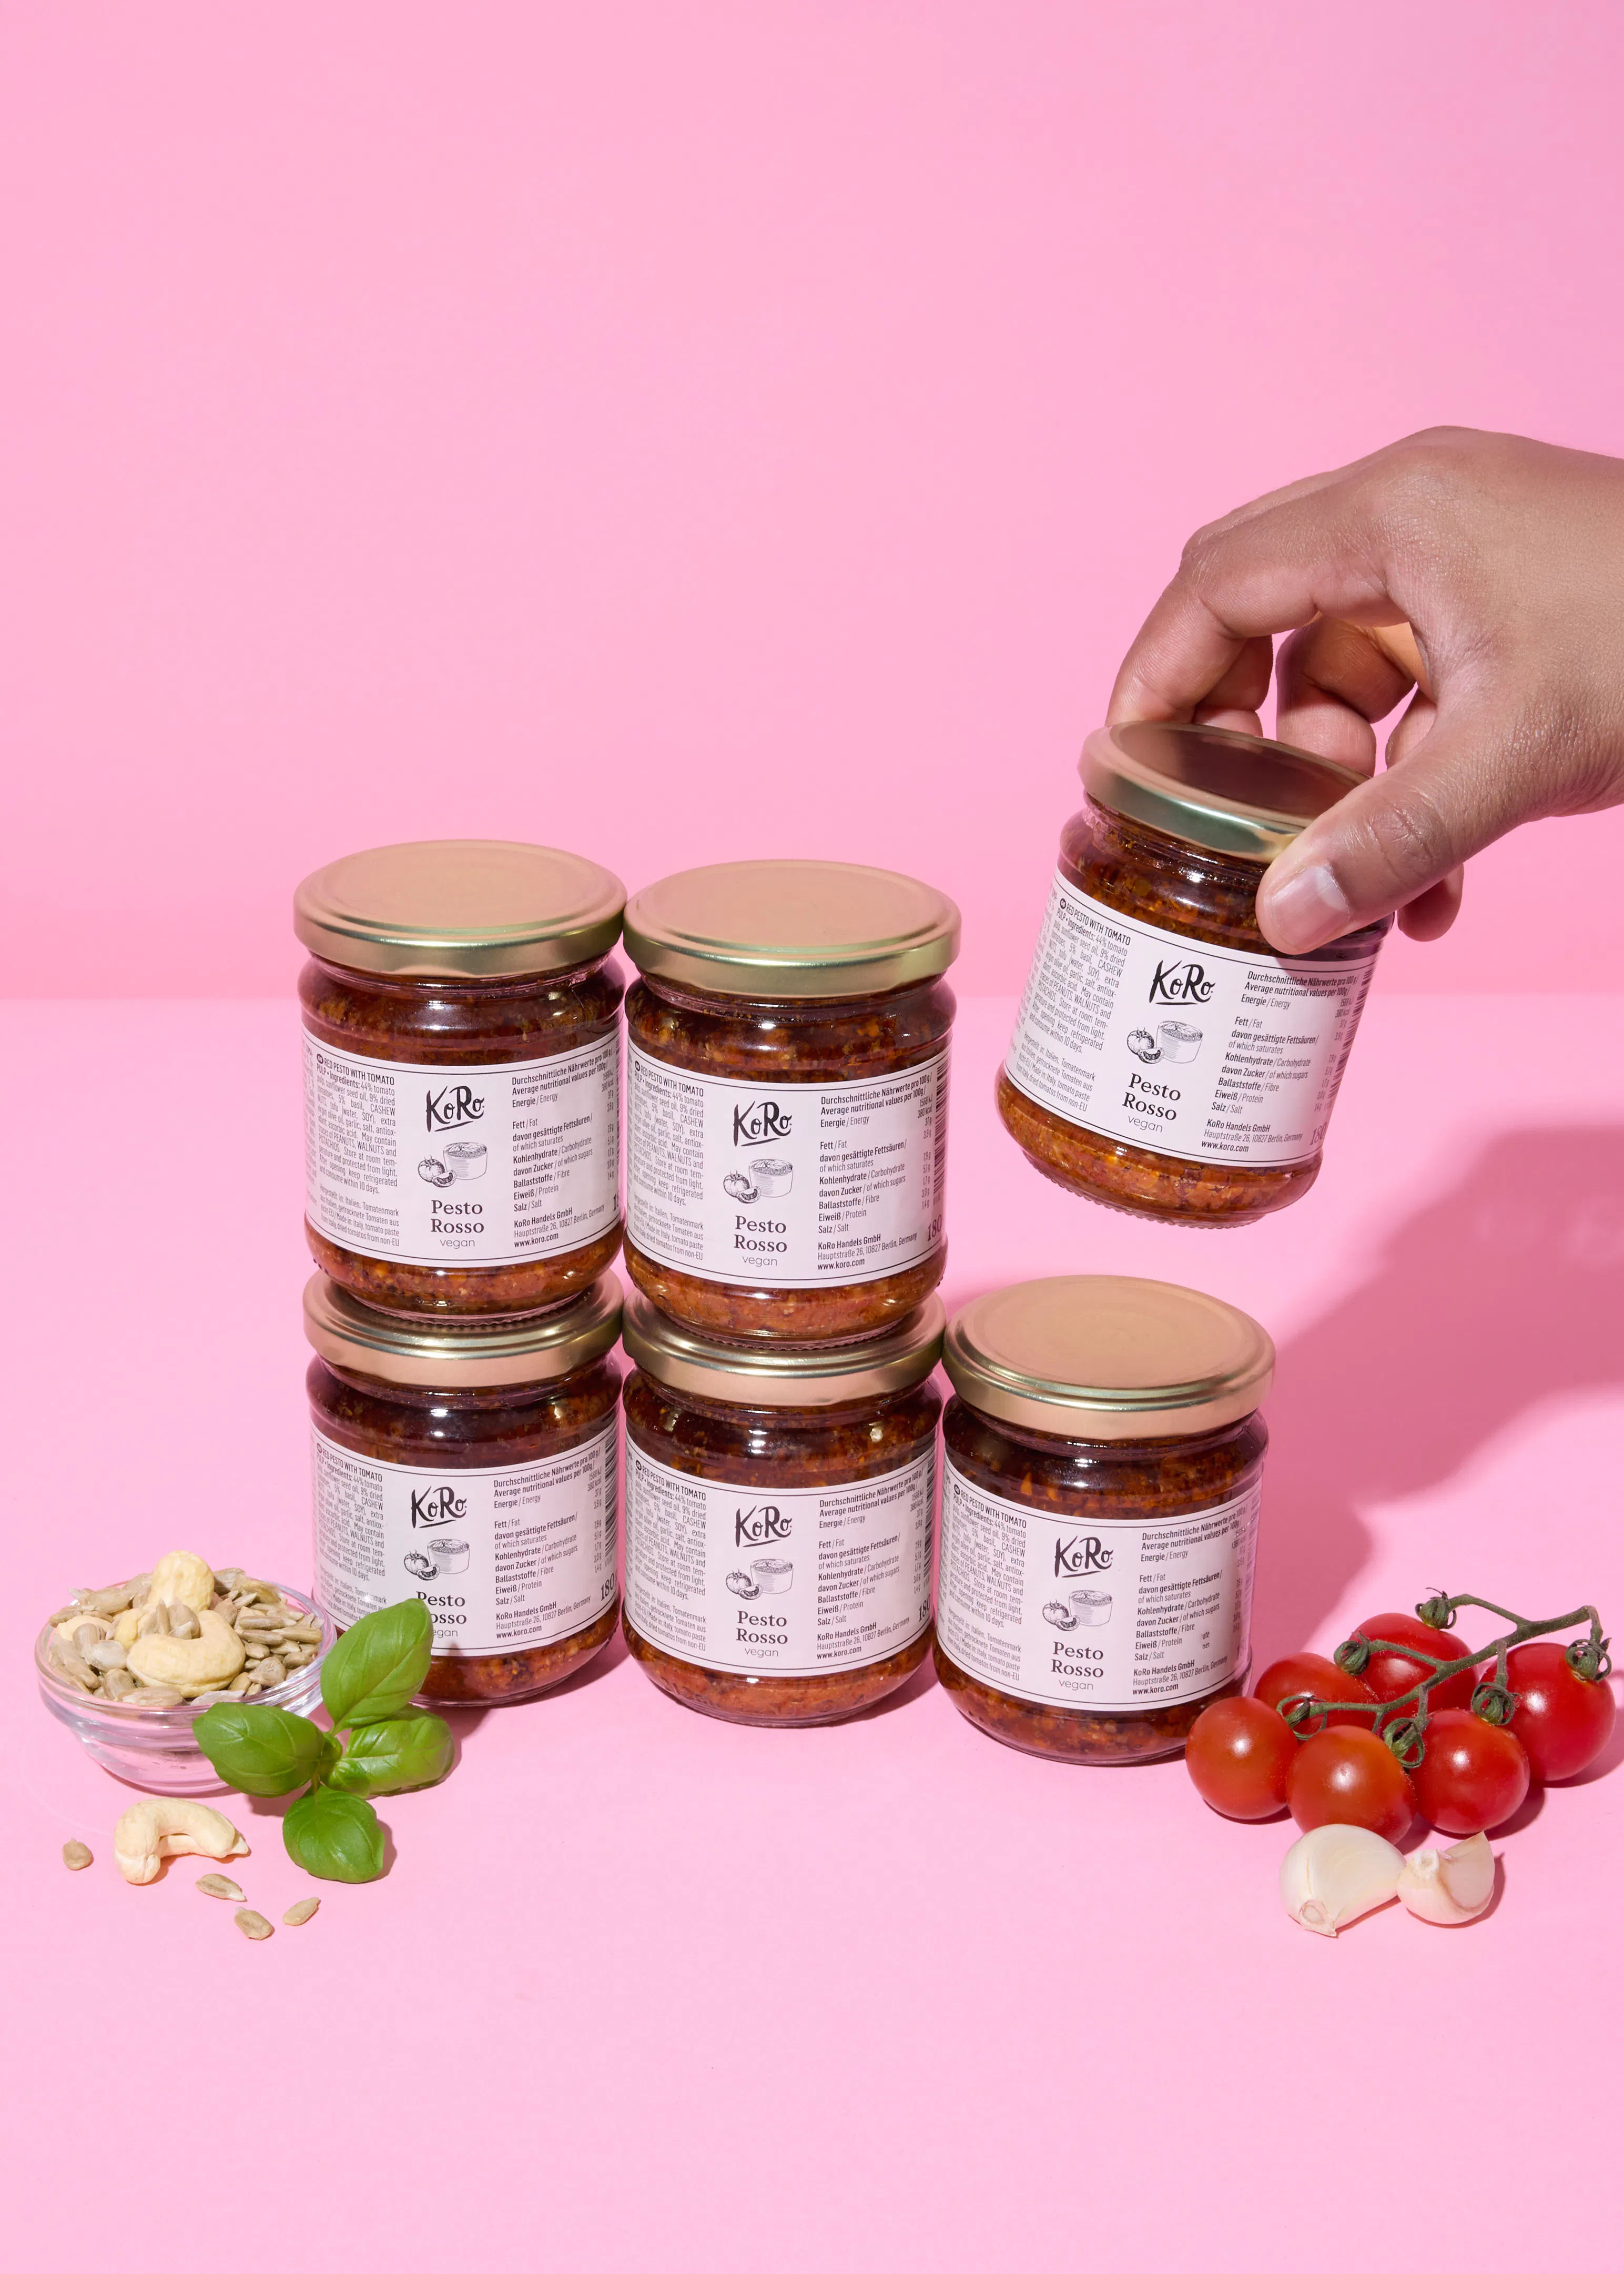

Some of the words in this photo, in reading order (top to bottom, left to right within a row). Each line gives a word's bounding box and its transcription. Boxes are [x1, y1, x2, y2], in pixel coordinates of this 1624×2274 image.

[1073, 909, 1090, 926] PESTO
[1088, 918, 1104, 934] WITH
[1103, 926, 1132, 946] TOMATO
[1247, 971, 1307, 986] Durchschnittliche
[1073, 995, 1101, 1014] WALNUTS
[1100, 1009, 1112, 1019] and
[1092, 993, 1115, 1008] contain
[1070, 1030, 1104, 1050] refrigerated
[1229, 1040, 1237, 1049] of
[1236, 1041, 1256, 1052] which
[1255, 1045, 1284, 1054] saturates
[333, 1063, 349, 1076] PESTO
[350, 1068, 366, 1080] WITH
[367, 1073, 394, 1085] TOMATO
[512, 1068, 567, 1085] Durchschnittliche
[567, 1058, 594, 1073] Nährwerte
[374, 1086, 395, 1096] tomato
[648, 1070, 662, 1084] PESTO
[663, 1077, 677, 1090] WITH
[678, 1082, 704, 1097] TOMATO
[1128, 1073, 1182, 1103] Pesto
[684, 1096, 704, 1107] tomato
[821, 1107, 849, 1115] Average
[851, 1099, 884, 1113] nutritional
[885, 1096, 903, 1106] values
[904, 1093, 912, 1103] per
[1121, 1091, 1178, 1122] Rosso
[370, 1104, 395, 1116] CASHEW
[689, 1107, 704, 1118] dried
[381, 1118, 395, 1126] extra
[1126, 1115, 1164, 1136] vegan
[1206, 1119, 1225, 1129] KoRo
[1225, 1121, 1252, 1131] Handels
[1252, 1123, 1271, 1133] GmbH
[1204, 1129, 1242, 1141] Hauptstraße
[1252, 1135, 1268, 1144] 10827
[683, 1147, 703, 1159] contain
[1201, 1141, 1250, 1153] www.koro.com
[363, 1175, 397, 1187] refrigerated
[362, 1201, 399, 1216] Tomatenmark
[431, 1199, 483, 1215] Pesto
[514, 1219, 530, 1228] KoRo
[532, 1212, 555, 1225] Handels
[556, 1207, 572, 1219] GmbH
[735, 1215, 787, 1234] Pesto
[431, 1218, 484, 1233] Rosso
[514, 1224, 549, 1238] Hauptstraße
[559, 1217, 573, 1228] 10827
[927, 1214, 942, 1241] 180
[440, 1239, 475, 1249] vegan
[514, 1232, 559, 1248] www.koro.com
[734, 1234, 787, 1253] Rosso
[837, 1238, 862, 1248] Handels
[864, 1234, 881, 1244] GmbH
[685, 1250, 703, 1260] non-EU
[818, 1249, 855, 1260] Hauptstraße
[866, 1244, 881, 1254] 10827
[742, 1256, 777, 1268] vegan
[817, 1258, 865, 1270] www.koro.com
[358, 1467, 382, 1482] TOMATO
[494, 1471, 550, 1488] Durchschnittliche
[551, 1460, 580, 1476] Nährwerte
[651, 1471, 665, 1486] PESTO
[665, 1480, 679, 1493] WITH
[681, 1485, 706, 1501] TOMATO
[370, 1491, 383, 1501] dried
[361, 1497, 383, 1511] CASHEW
[687, 1499, 706, 1510] tomato
[819, 1508, 846, 1517] Average
[848, 1499, 879, 1513] nutritional
[880, 1493, 897, 1504] values
[969, 1496, 984, 1512] PESTO
[985, 1505, 1000, 1519] WITH
[1000, 1512, 1027, 1529] TOMATO
[683, 1515, 706, 1529] CASHEW
[365, 1527, 384, 1539] contain
[495, 1531, 514, 1540] davon
[515, 1524, 546, 1539] gesättigte
[1142, 1527, 1200, 1541] Durchschnittliche
[685, 1546, 706, 1558] contain
[601, 1573, 614, 1601] 180
[818, 1584, 837, 1593] davon
[838, 1580, 859, 1589] Zucker
[416, 1591, 465, 1607] Pesto
[1146, 1593, 1164, 1603] which
[1164, 1591, 1191, 1602] saturates
[496, 1612, 513, 1621] KoRo
[514, 1606, 539, 1618] Handels
[540, 1601, 556, 1612] GmbH
[990, 1608, 1022, 1624] refrigerated
[496, 1618, 532, 1630] Hauptstraße
[542, 1610, 556, 1621] 10827
[737, 1610, 787, 1628] Pesto
[496, 1625, 542, 1639] www.koro.com
[736, 1628, 788, 1645] Rosso
[817, 1633, 834, 1641] KoRo
[835, 1627, 859, 1639] Handels
[860, 1622, 877, 1633] GmbH
[817, 1638, 852, 1650] Hauptstraße
[862, 1631, 876, 1642] 10827
[987, 1633, 1022, 1652] Tomatenmark
[744, 1648, 778, 1659] vegan
[817, 1646, 862, 1659] www.koro.com
[1011, 1653, 1021, 1662] aus
[1052, 1641, 1104, 1661] Pesto
[1051, 1659, 1104, 1679] Rosso
[1152, 1664, 1177, 1674] Handels
[1178, 1660, 1195, 1670] GmbH
[1133, 1675, 1169, 1686] Hauptstraße
[1180, 1669, 1194, 1679] 10827
[1058, 1679, 1094, 1693] vegan
[1132, 1683, 1179, 1695] www.koro.com
